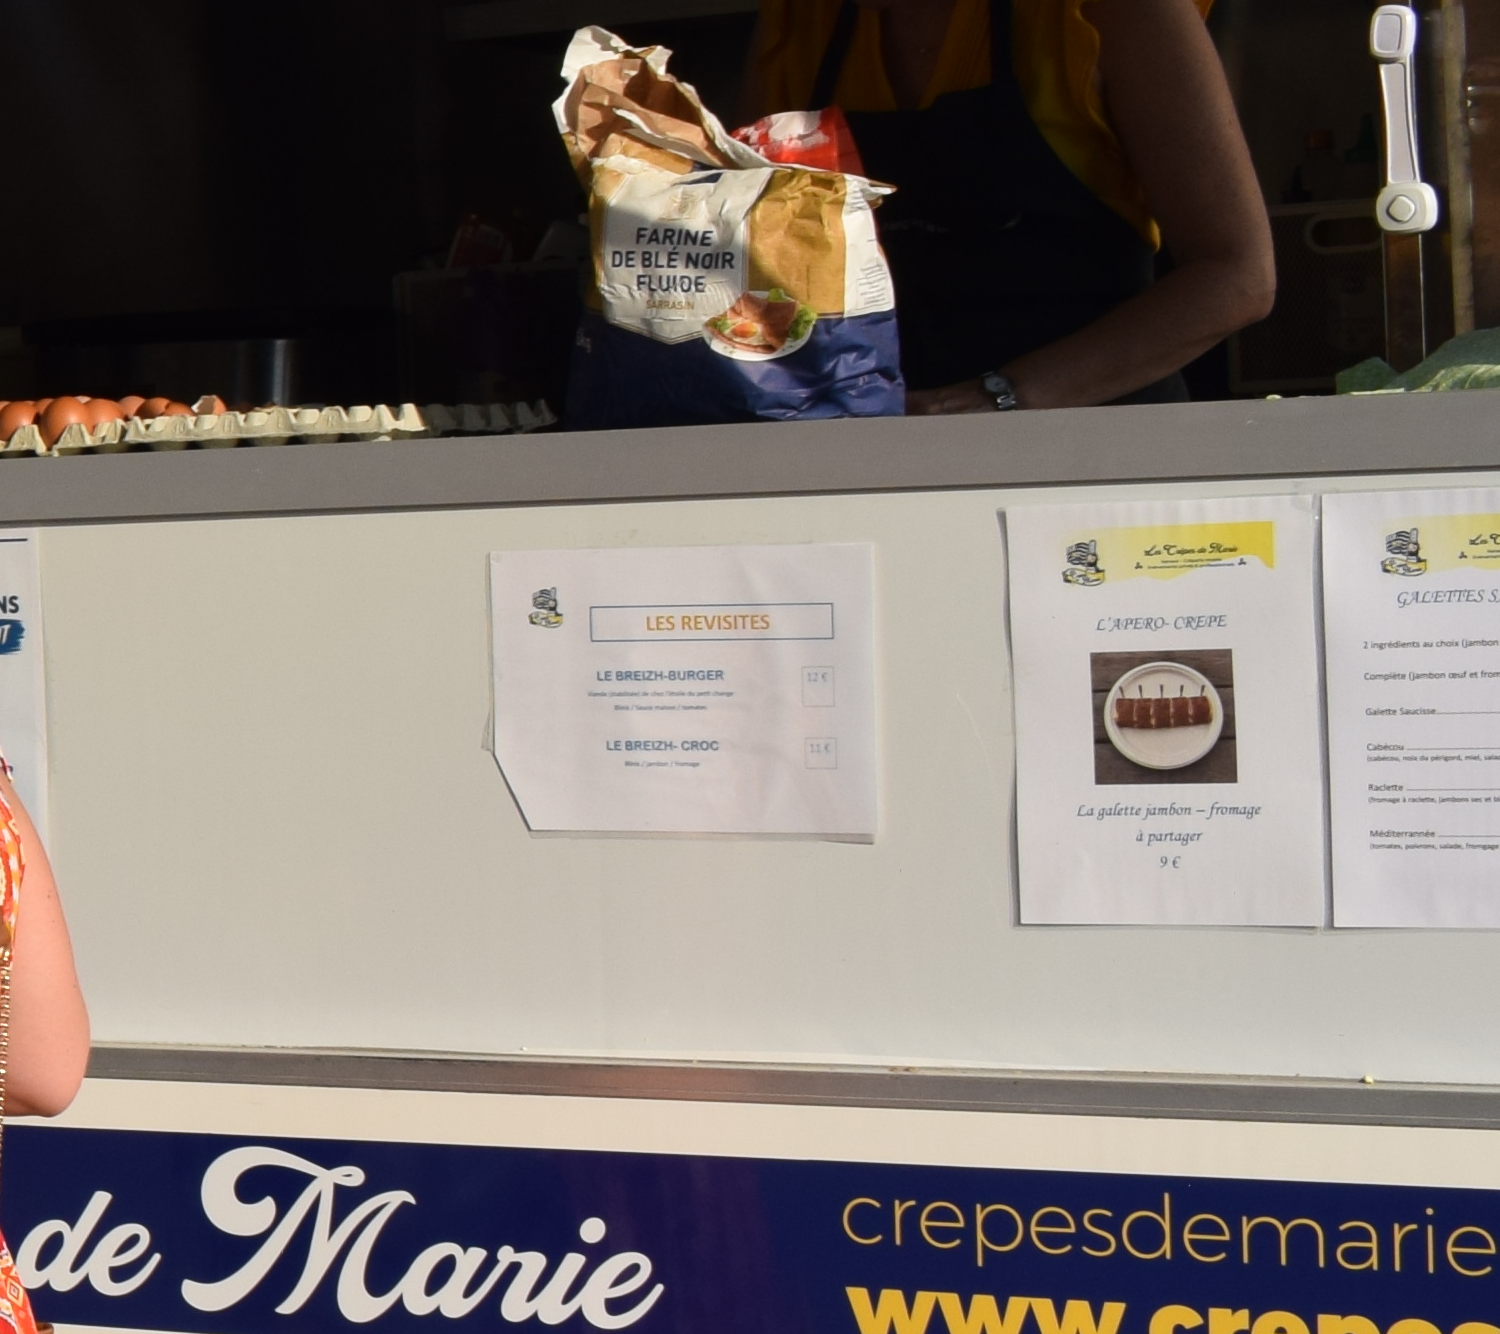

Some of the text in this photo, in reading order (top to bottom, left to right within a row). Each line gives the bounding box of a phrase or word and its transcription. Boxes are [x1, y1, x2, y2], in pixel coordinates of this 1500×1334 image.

[635, 227, 714, 247] FARINE
[611, 246, 735, 269] DE BLÉ NOIR
[636, 274, 706, 293] FLUIDE
[1397, 589, 1485, 608] GALETTES
[646, 614, 771, 631] LES REVISITES
[1174, 614, 1228, 629] CREPE
[1435, 639, 1459, 647] choix
[596, 670, 613, 682] LE
[615, 669, 725, 681] BREIZH-BURGER
[1400, 707, 1436, 715] Saucisse
[606, 740, 622, 751] LE
[681, 740, 720, 752] CROC
[1077, 802, 1261, 820] La galette jambon fromage
[1135, 830, 1203, 846] à partager
[1160, 855, 1181, 868] 9 €
[15, 1189, 162, 1298] de
[181, 1145, 666, 1331] Marie
[842, 1192, 1498, 1277] crepesdemarie
